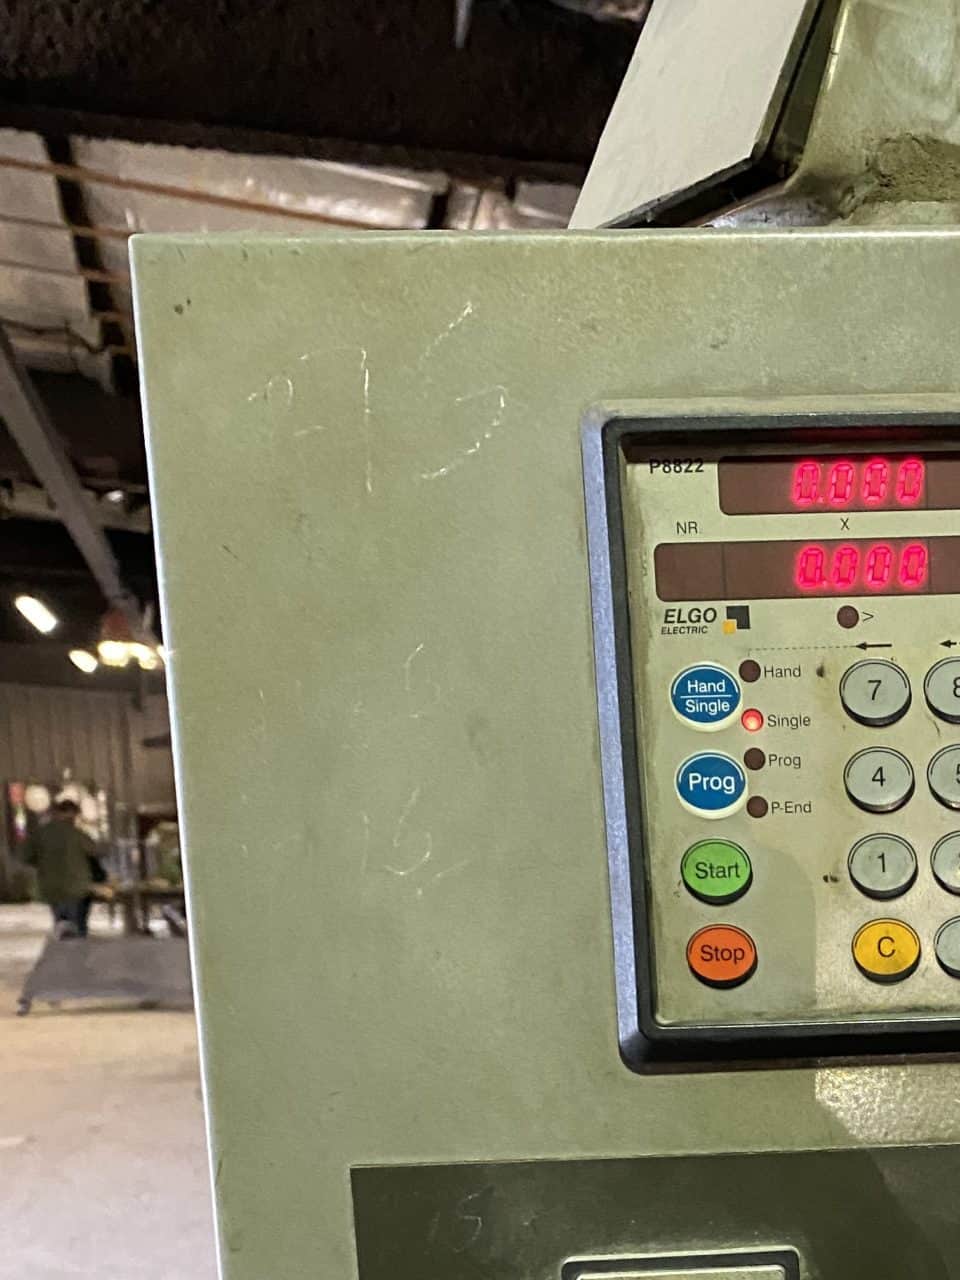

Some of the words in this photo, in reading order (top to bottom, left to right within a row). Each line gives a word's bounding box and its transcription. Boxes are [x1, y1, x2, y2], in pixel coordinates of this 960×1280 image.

[649, 457, 705, 475] P8822
[676, 521, 698, 535] NR
[840, 517, 850, 531] X
[663, 607, 718, 624] ELGO
[660, 625, 709, 636] ELECTRIC
[764, 665, 802, 679] Hand
[686, 678, 727, 694] Hand
[867, 679, 883, 701] 7
[684, 698, 731, 716] Single
[766, 714, 812, 730] Single
[767, 752, 802, 769] Prog
[688, 772, 737, 794] Prog
[871, 765, 887, 787] 4
[770, 801, 813, 815] P-End
[694, 861, 741, 879] Start
[877, 852, 886, 873] 1
[700, 944, 746, 966] Stop
[877, 935, 897, 958] C
